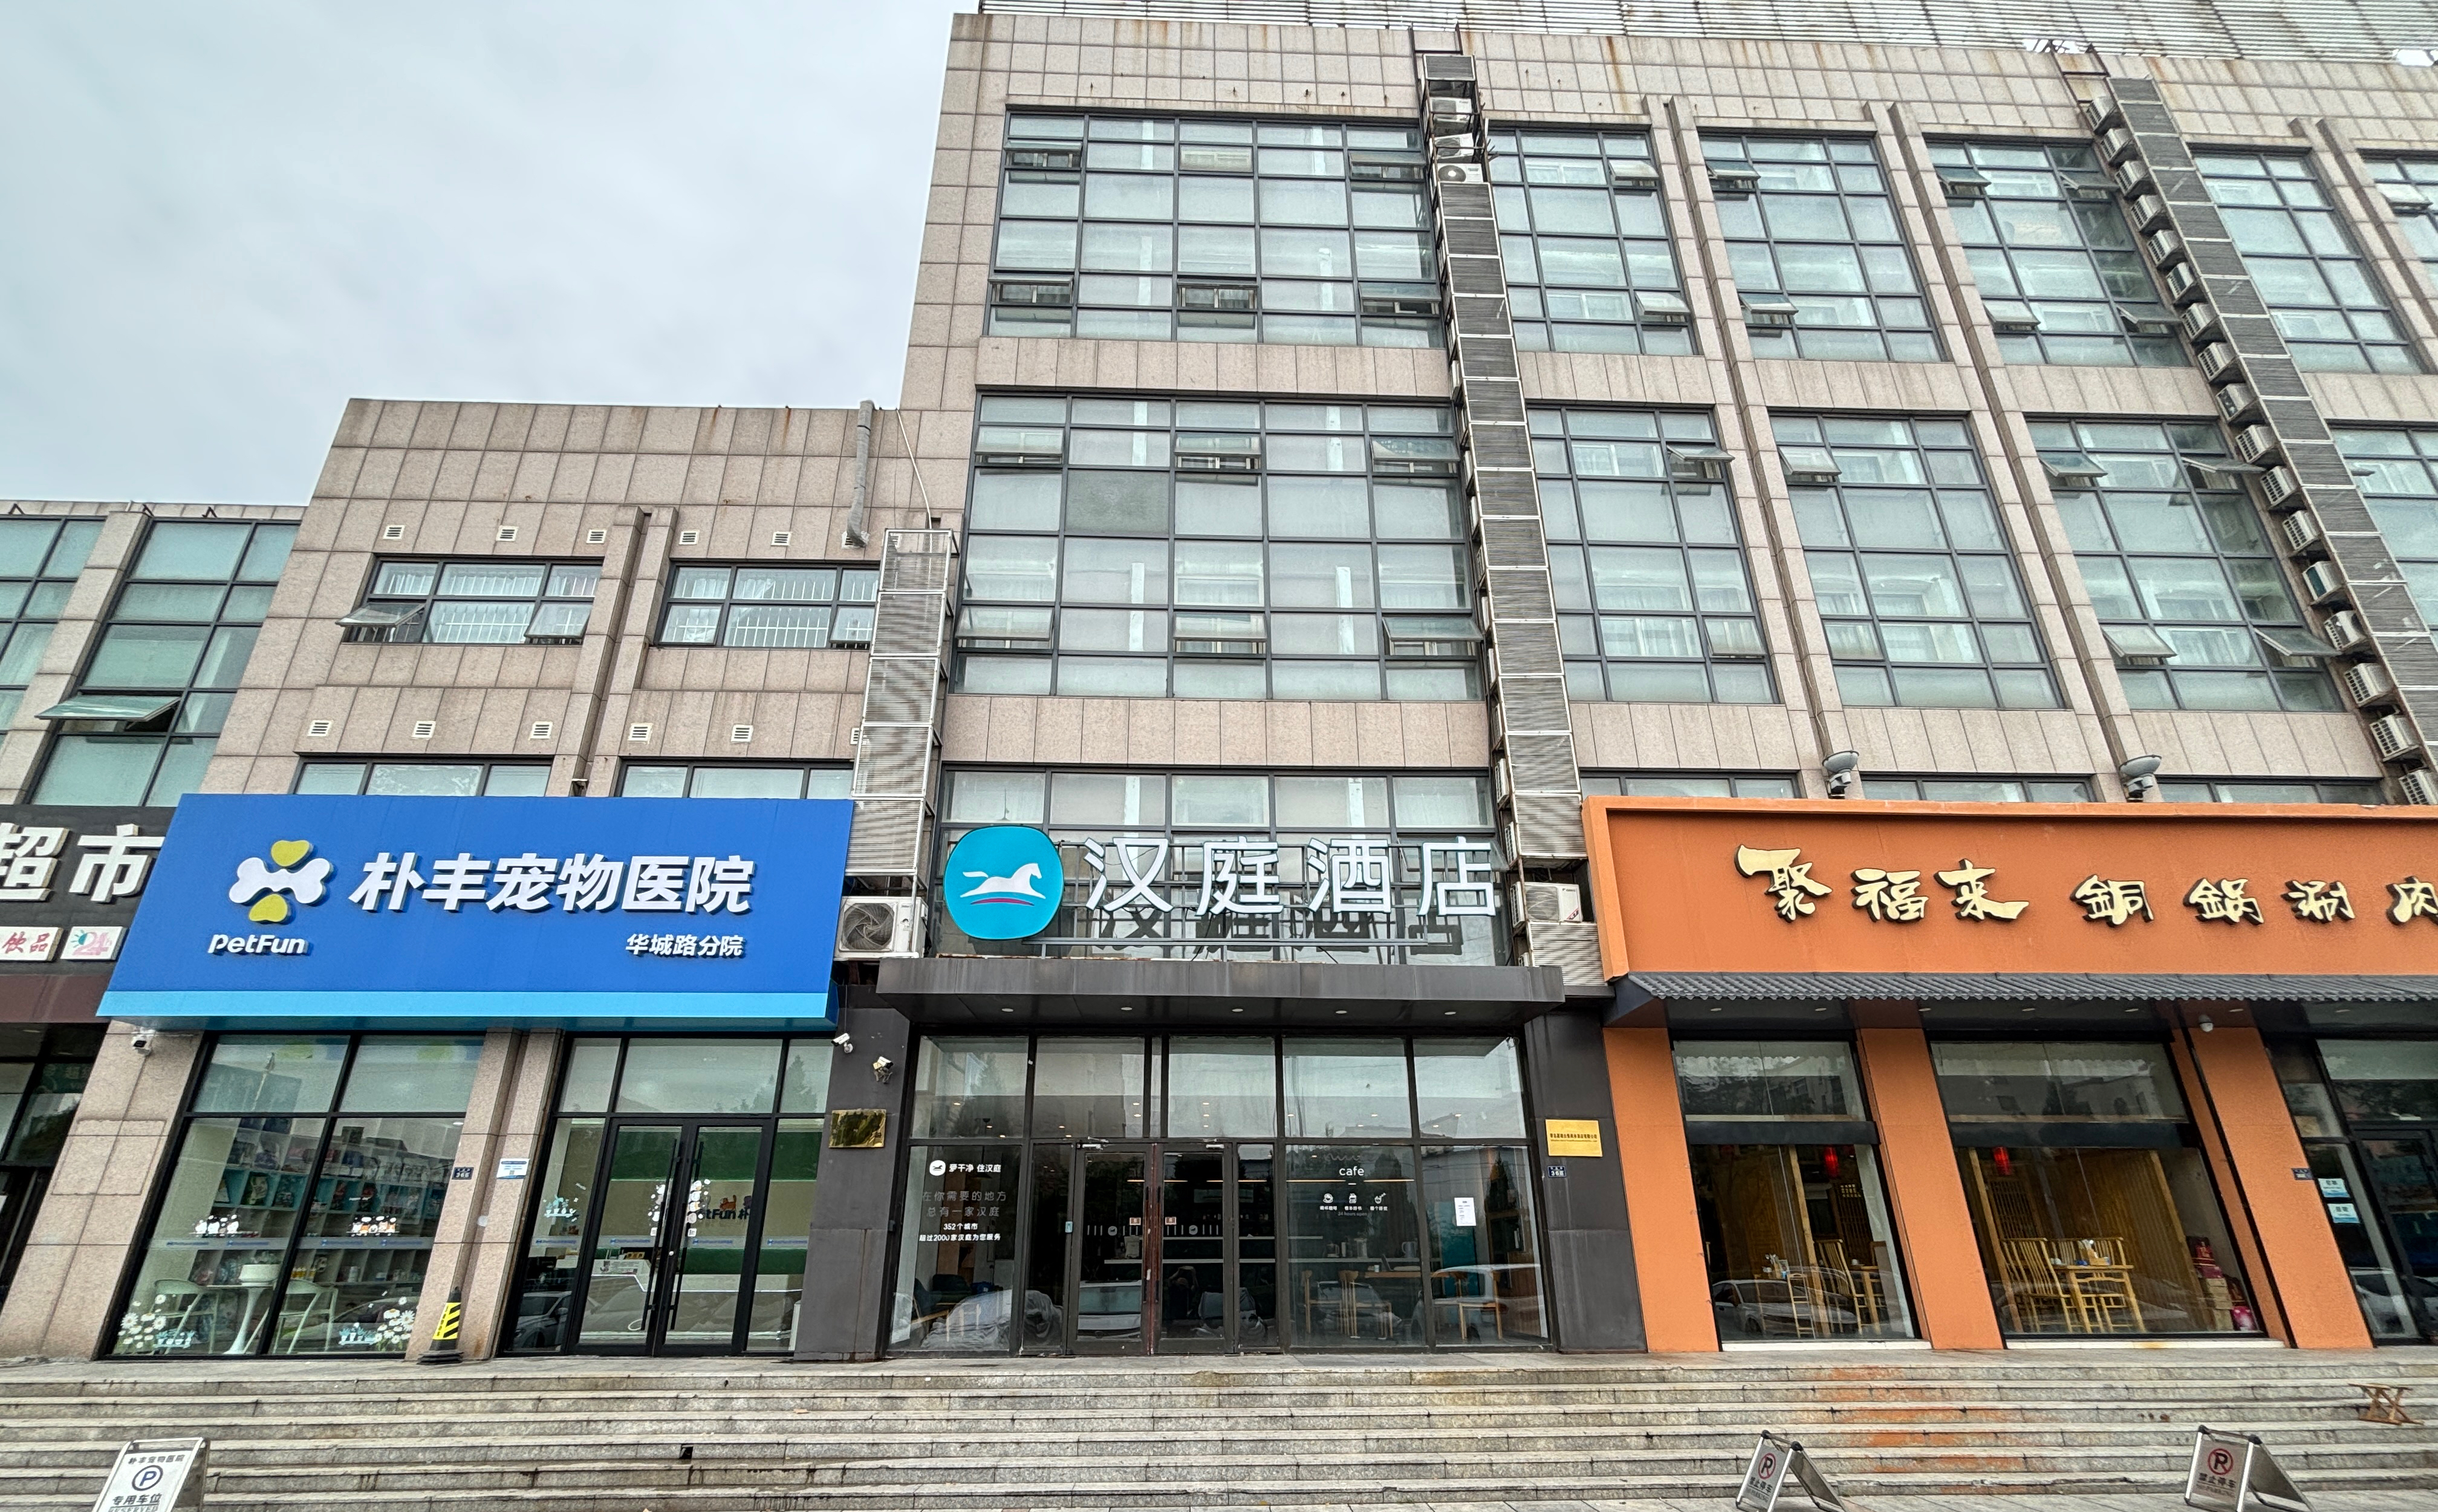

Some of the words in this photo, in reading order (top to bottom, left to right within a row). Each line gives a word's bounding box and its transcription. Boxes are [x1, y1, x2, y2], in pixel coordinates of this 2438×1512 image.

[0, 822, 165, 903] 超市
[348, 852, 756, 913] 朴丰宠物医院
[1084, 835, 1495, 917] 汉庭酒店
[1734, 845, 2030, 922] 聚福来
[2, 930, 51, 954] 饮品
[625, 933, 744, 956] 华城路分院
[977, 1164, 1002, 1173] 住汉庭
[1339, 1166, 1365, 1176] cafe
[923, 1191, 1006, 1201] 在你需要的地方
[926, 1207, 1000, 1217] 总有一家汉庭
[112, 1493, 163, 1505] 专用车位
